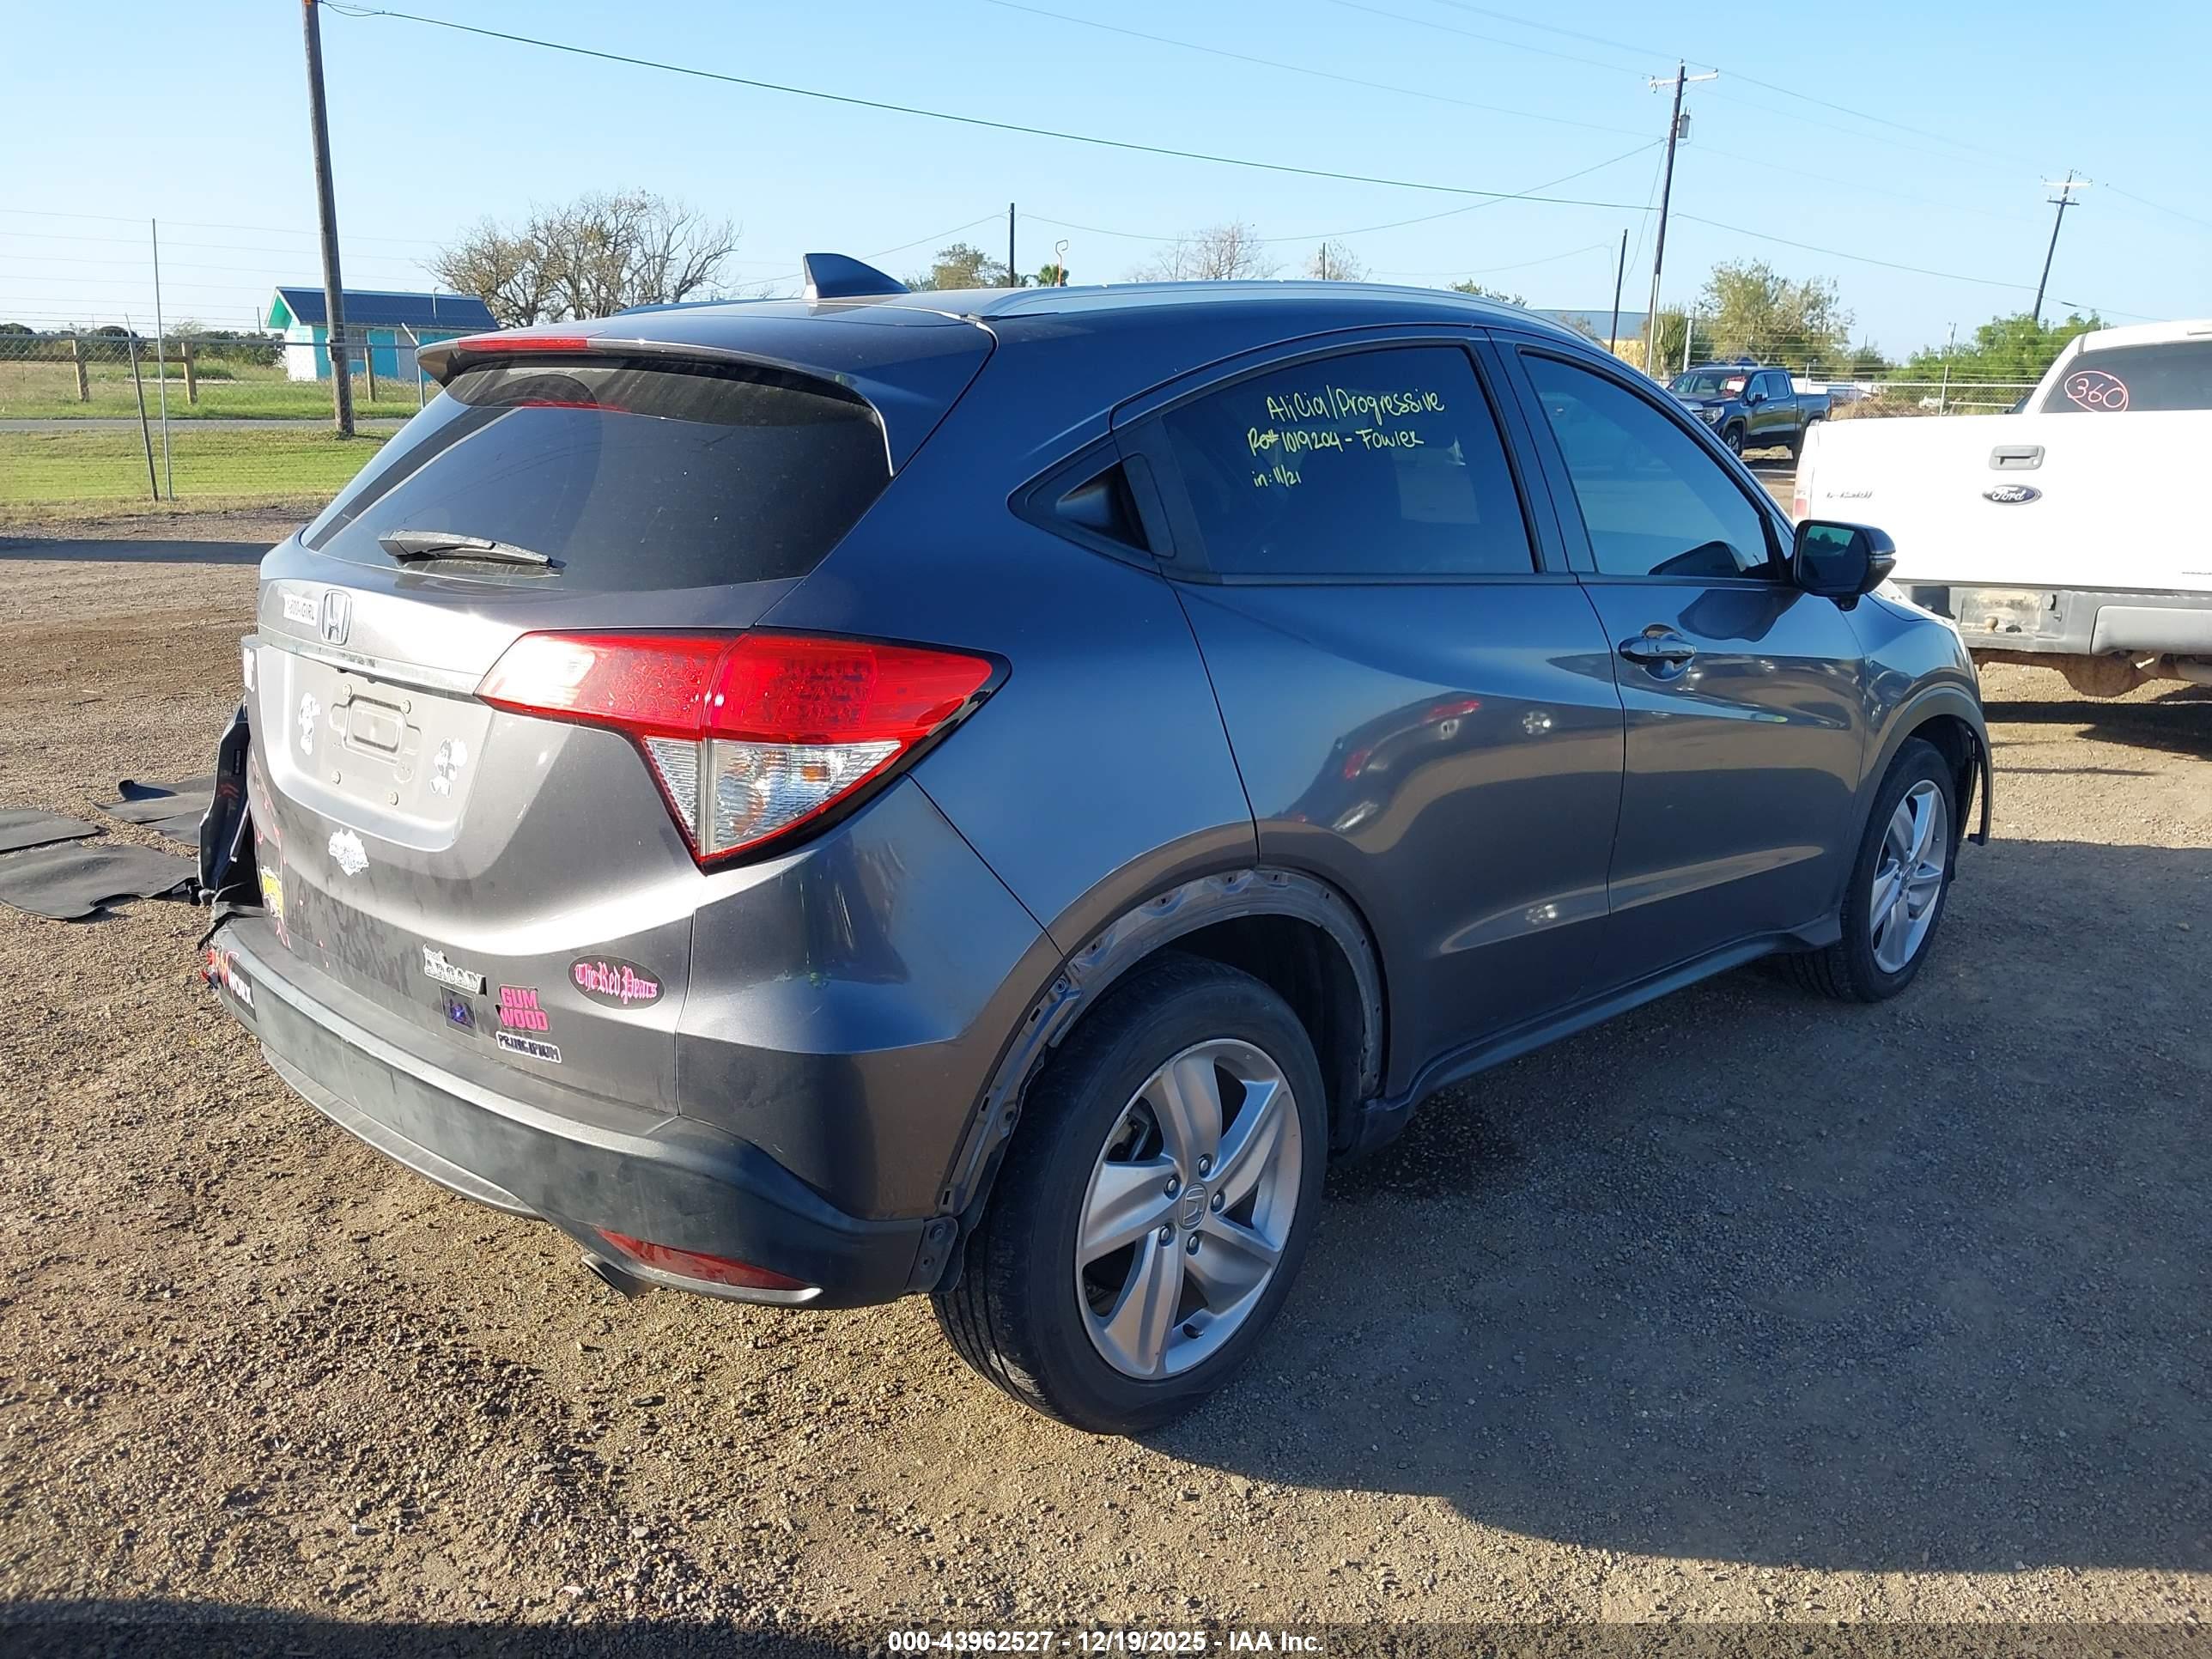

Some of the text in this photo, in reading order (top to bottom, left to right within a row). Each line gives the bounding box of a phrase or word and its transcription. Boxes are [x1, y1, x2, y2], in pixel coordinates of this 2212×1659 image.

[2075, 378, 2125, 409] 360
[1990, 485, 2027, 502] Ford
[574, 960, 658, 1005] The Red Pears
[500, 988, 538, 1010] GUM
[500, 1007, 549, 1031] WOOD
